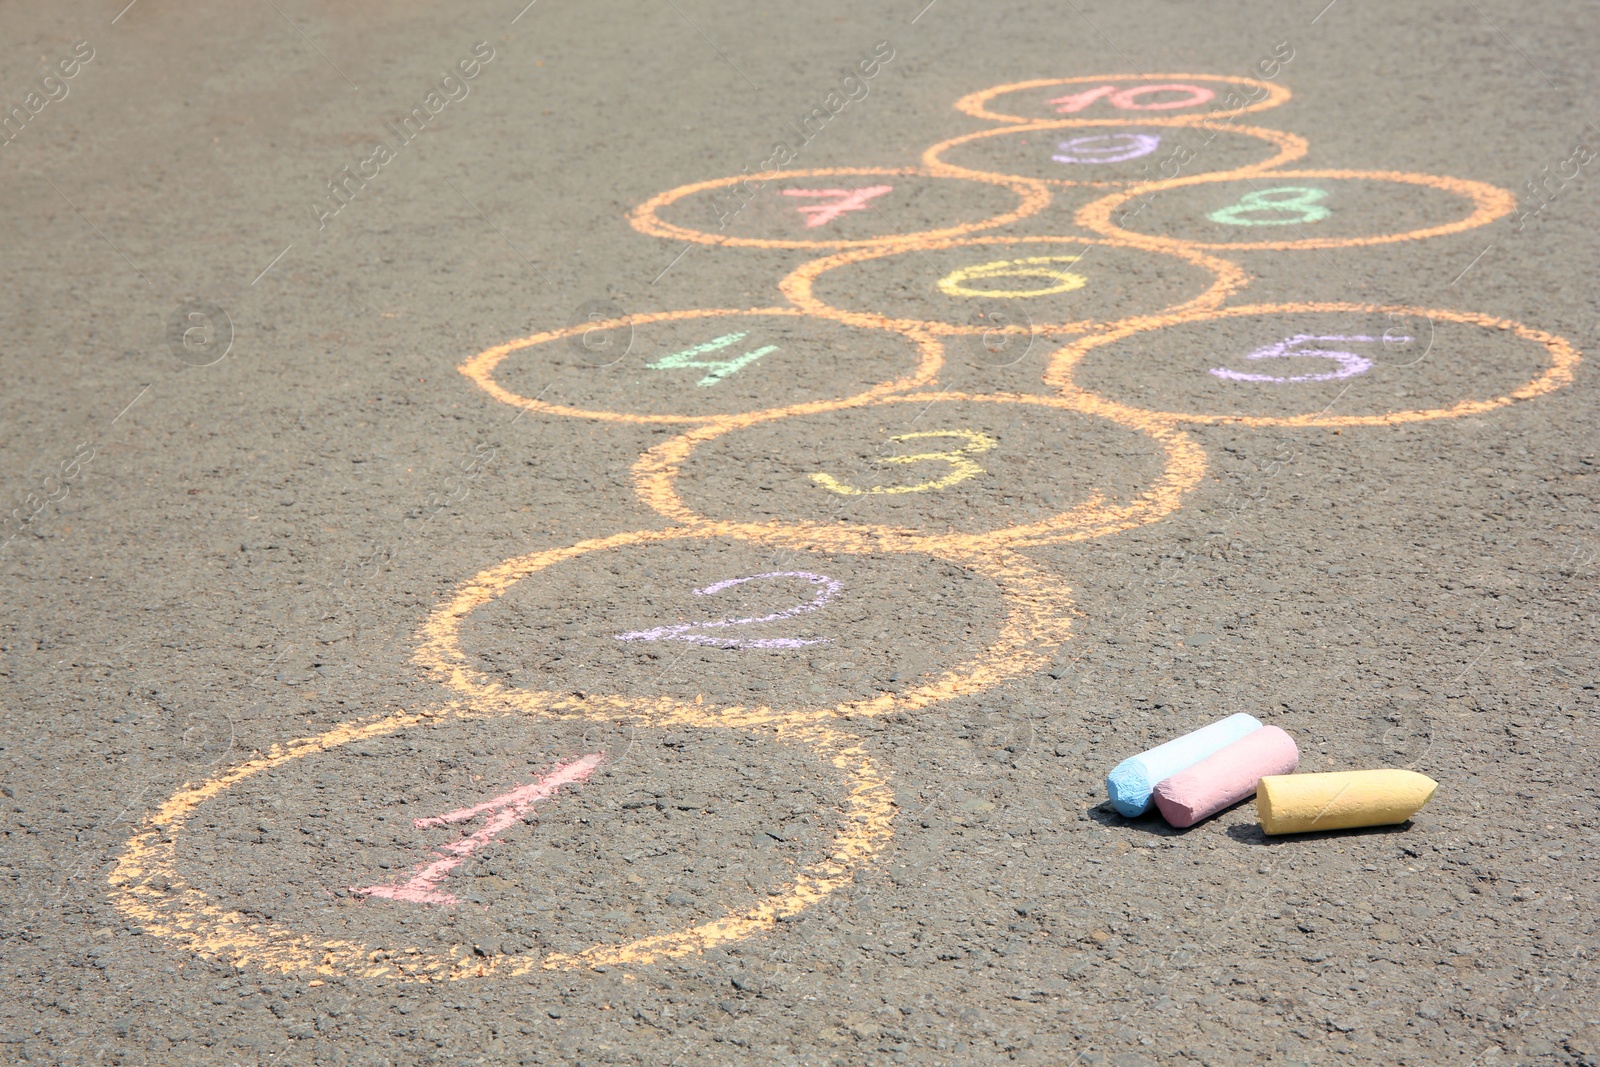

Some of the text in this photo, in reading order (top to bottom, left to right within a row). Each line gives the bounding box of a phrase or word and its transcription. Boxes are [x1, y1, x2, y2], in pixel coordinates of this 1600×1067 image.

[1050, 84, 1215, 113] 10
[1051, 132, 1161, 164] 9
[779, 184, 893, 228] 7
[1207, 186, 1331, 226] 8
[937, 255, 1087, 299] 6
[645, 329, 778, 387] 4
[1210, 333, 1414, 384] 5
[808, 429, 997, 496] 3
[614, 569, 844, 650] 2
[348, 753, 604, 907] 1
